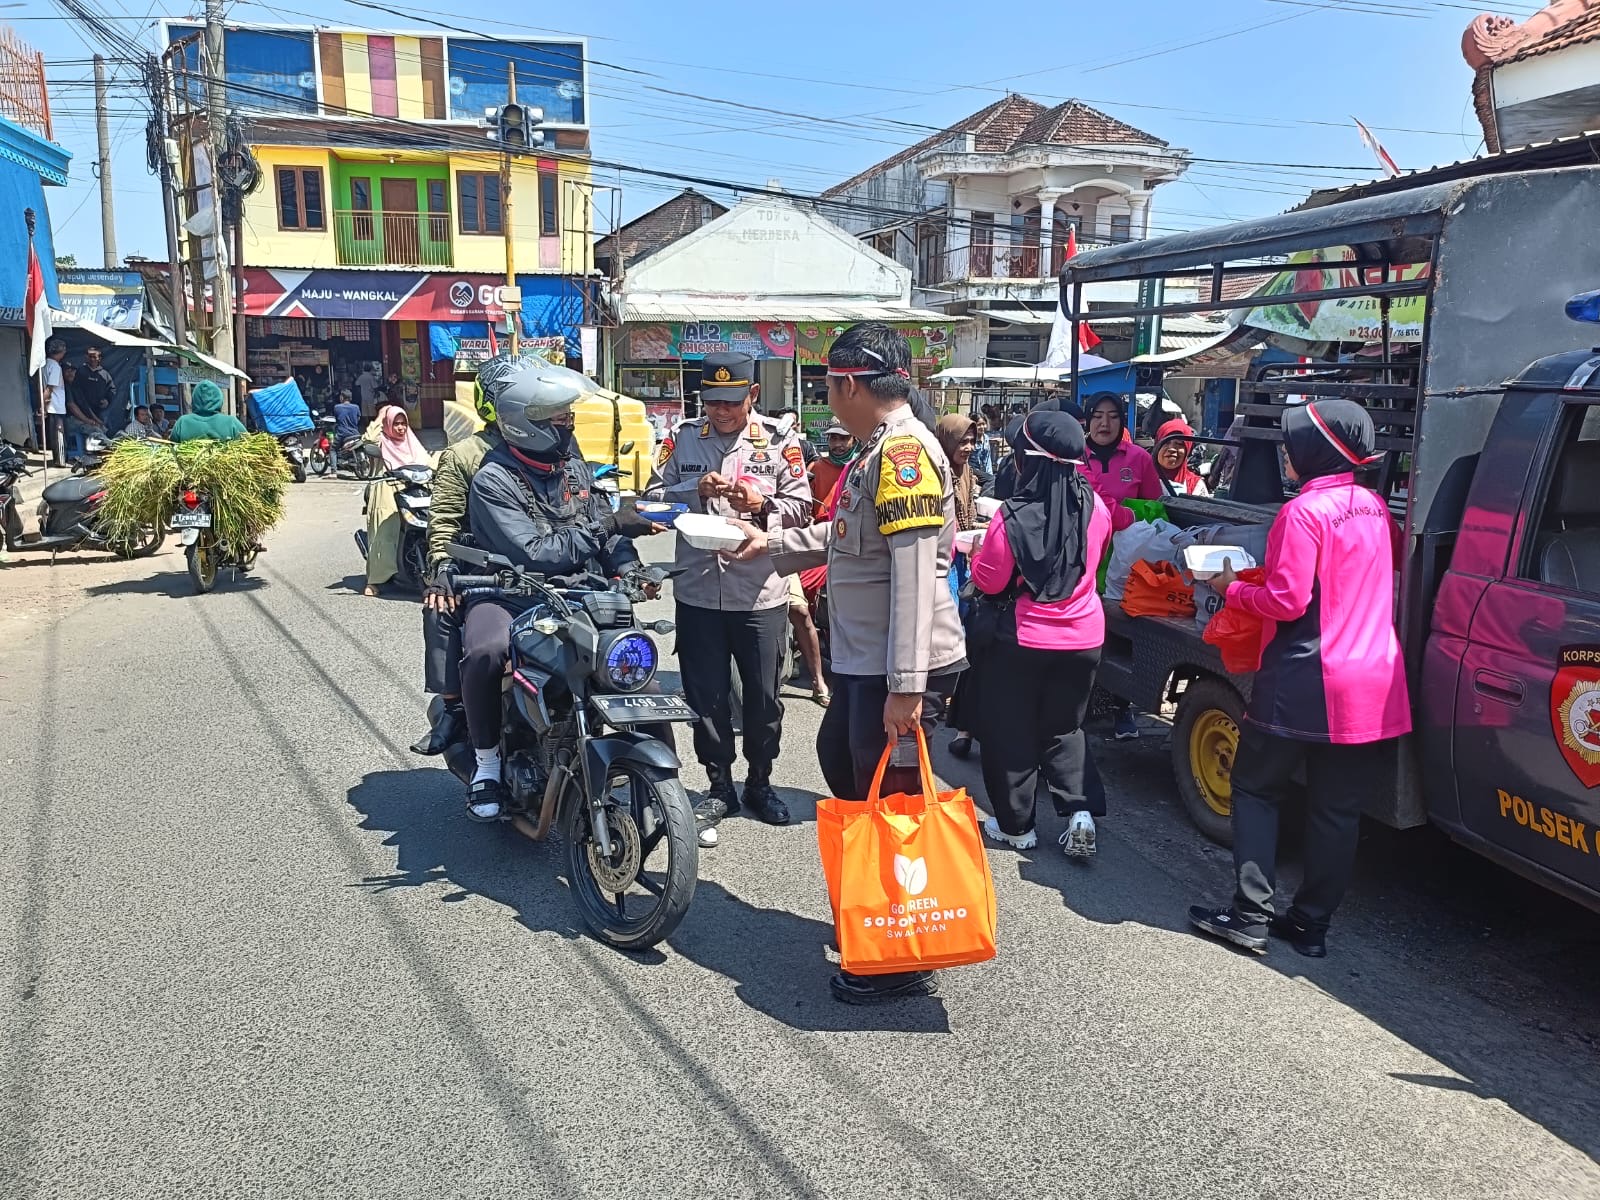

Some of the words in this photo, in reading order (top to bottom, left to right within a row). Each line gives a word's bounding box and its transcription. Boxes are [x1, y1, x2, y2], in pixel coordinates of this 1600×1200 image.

[742, 229, 801, 241] MERDEKA
[301, 289, 333, 299] MAJU
[342, 290, 399, 301] WANGKAL
[1336, 295, 1418, 311] WATERELON
[684, 322, 721, 341] AL2
[1405, 328, 1420, 337] BTG
[677, 342, 729, 354] CHICKEN
[743, 464, 775, 474] POLRI
[1562, 650, 1600, 662] KORPS
[624, 698, 658, 707] 4496
[1496, 788, 1589, 854] POLSEK
[891, 903, 905, 915] GO
[863, 907, 968, 929] SOPONYONO
[886, 923, 947, 939] SWALAYAN
